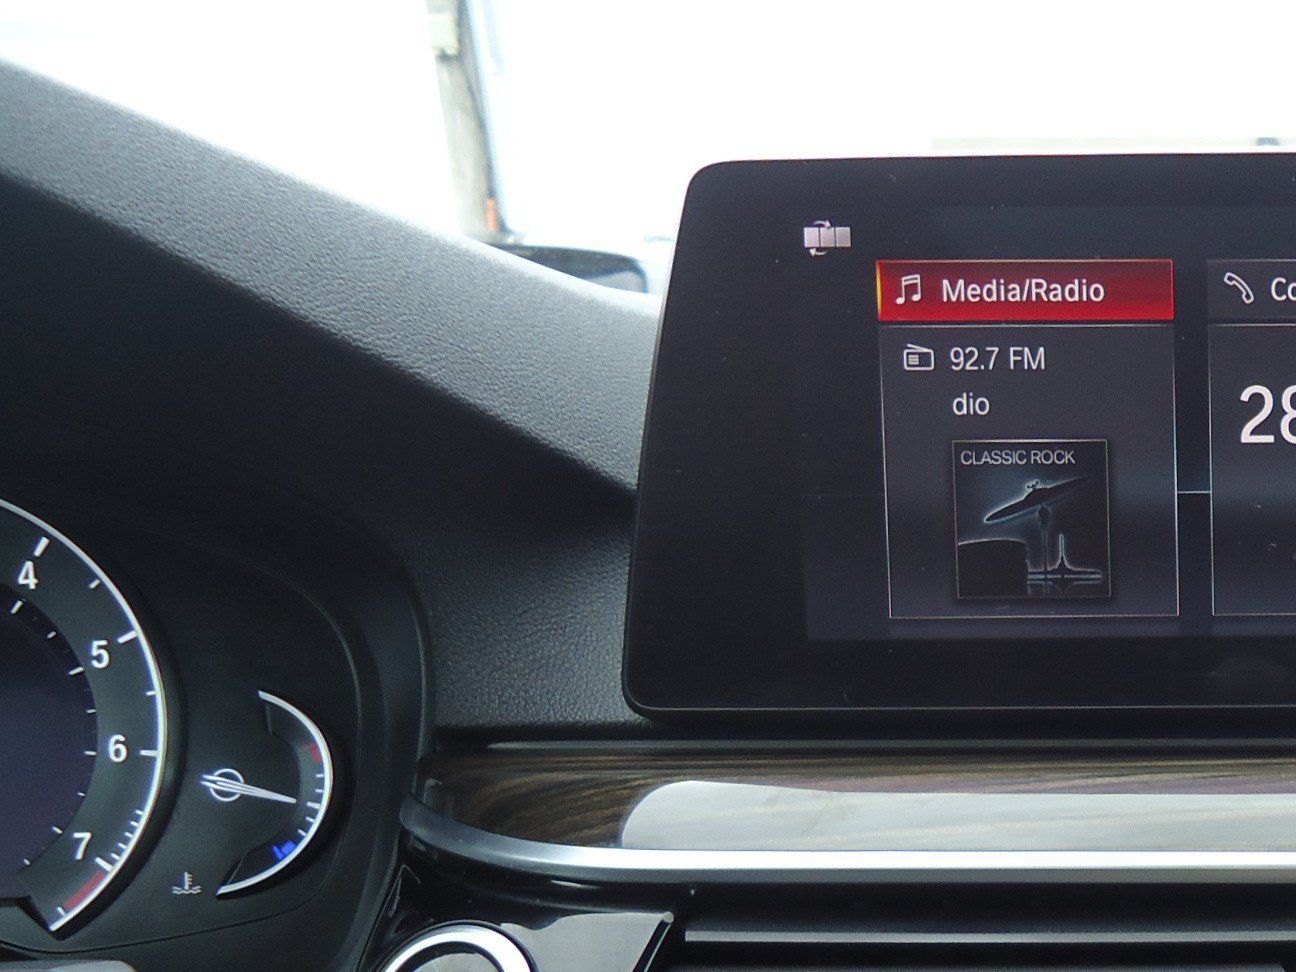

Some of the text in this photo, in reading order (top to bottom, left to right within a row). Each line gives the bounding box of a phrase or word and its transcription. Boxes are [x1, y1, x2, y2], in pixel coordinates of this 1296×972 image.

[941, 278, 1105, 303] Media/Radio
[949, 346, 1046, 371] 92.7 FM
[952, 392, 990, 416] dio
[960, 450, 1075, 466] CLASSIC ROCK
[17, 561, 39, 590] 4
[91, 640, 110, 668] 5
[107, 735, 128, 763] 6
[73, 832, 92, 860] 7
